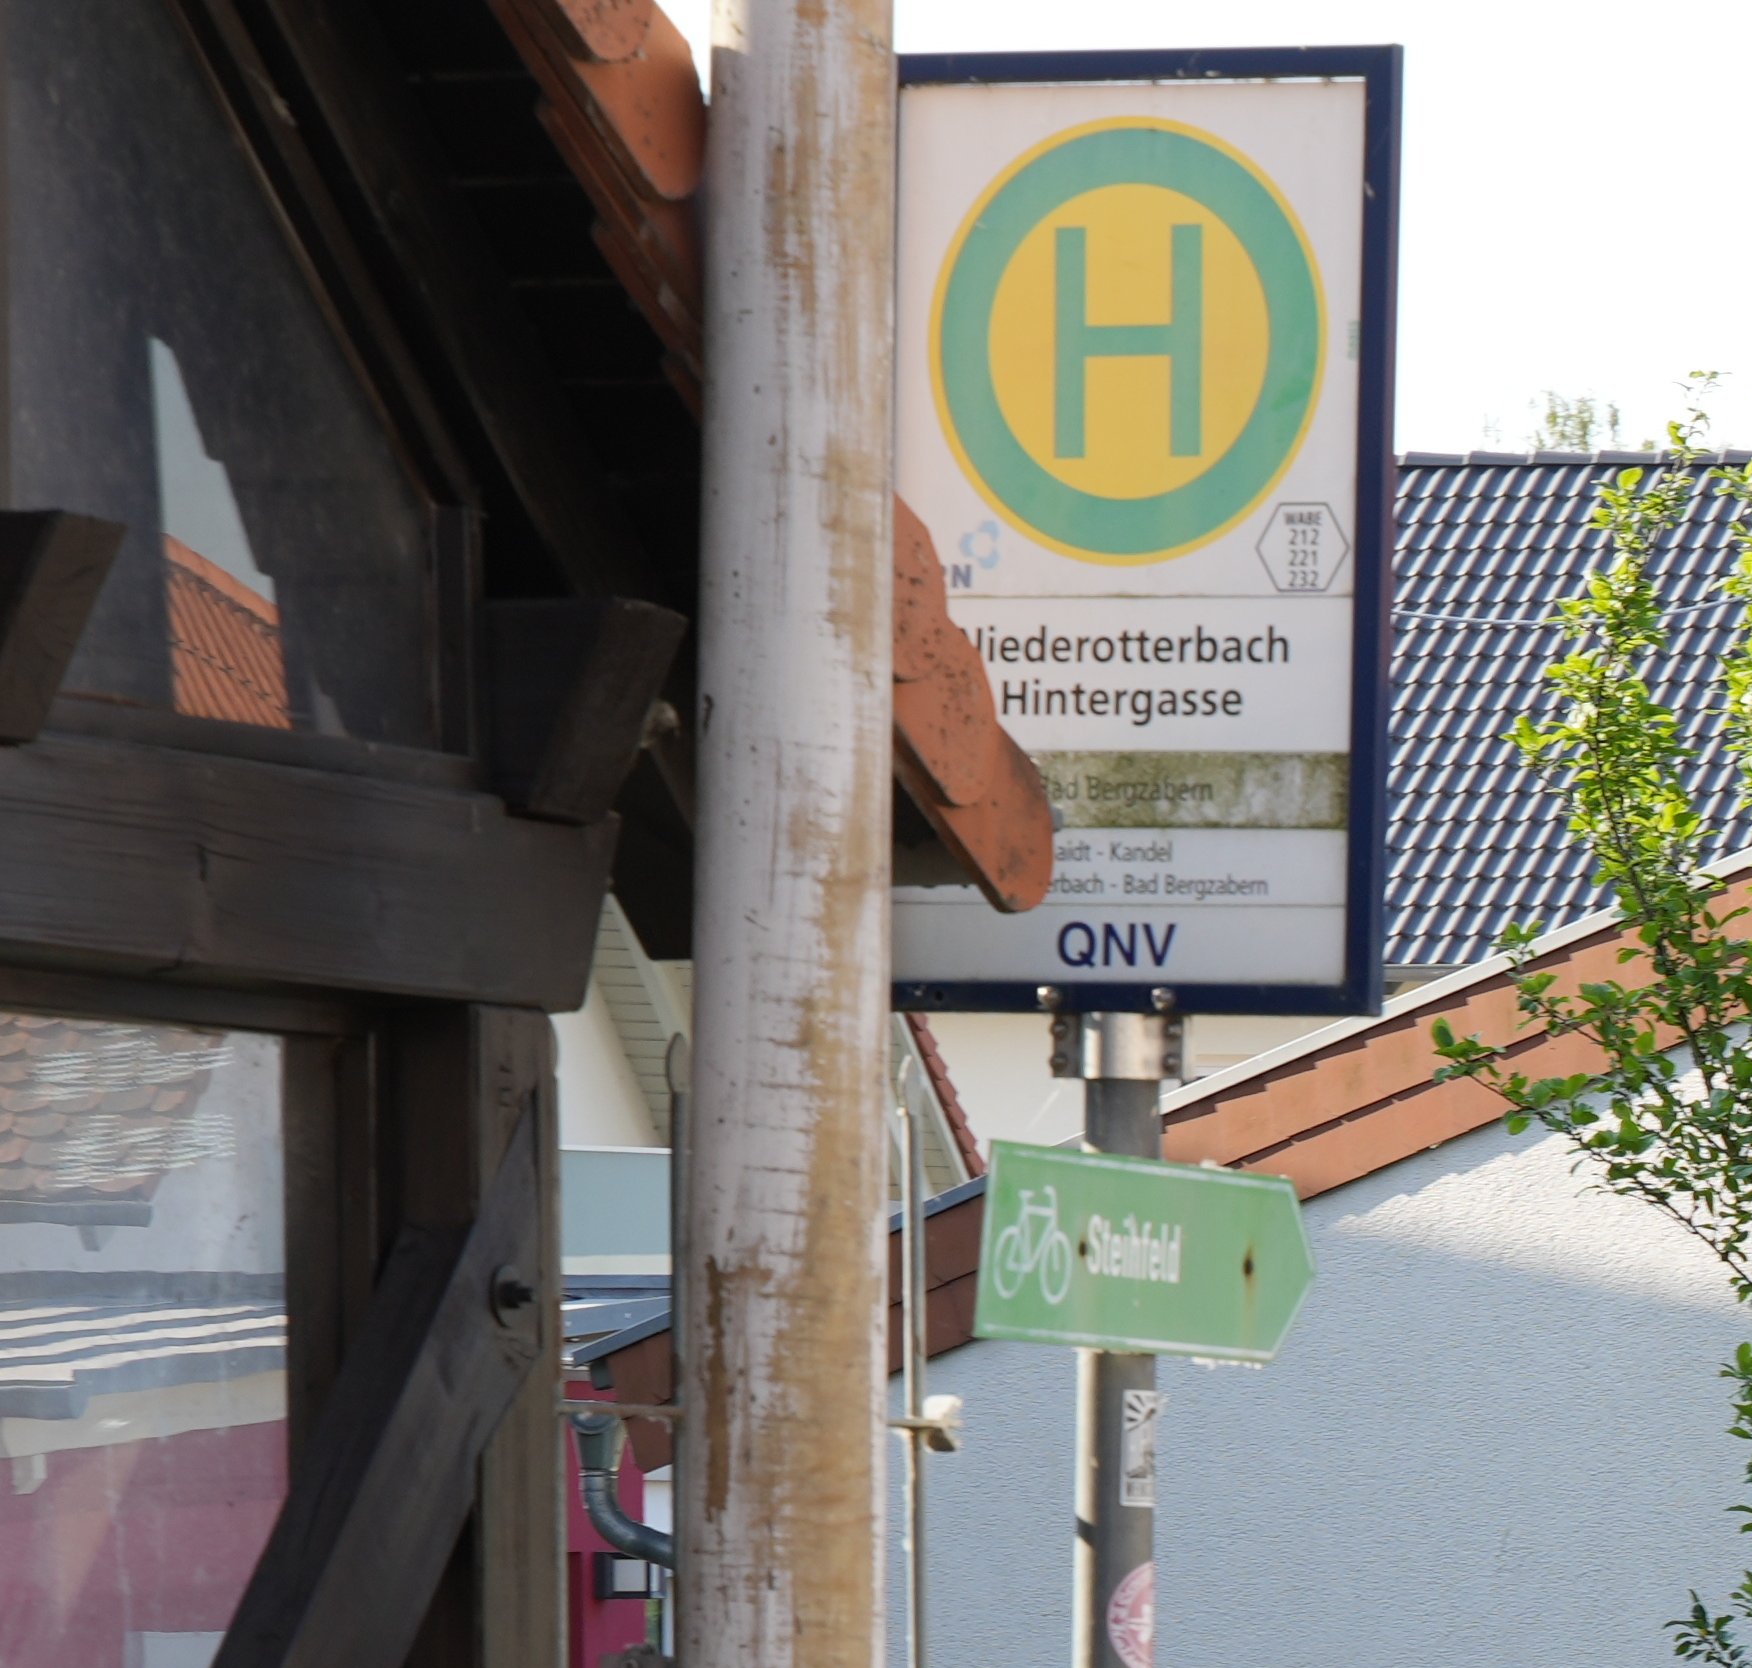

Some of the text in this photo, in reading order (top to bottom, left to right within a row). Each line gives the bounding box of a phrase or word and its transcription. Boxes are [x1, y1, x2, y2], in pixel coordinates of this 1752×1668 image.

[1054, 223, 1204, 460] H
[1284, 512, 1322, 526] WABE
[1288, 528, 1319, 545] 212
[1288, 549, 1318, 566] 221
[1288, 570, 1319, 587] 232
[1001, 679, 1244, 726] Hintergasse
[1109, 841, 1173, 863] Kandel
[1123, 874, 1159, 895] Bad
[1165, 875, 1269, 901] Bergzabern
[1057, 920, 1177, 968] QNV
